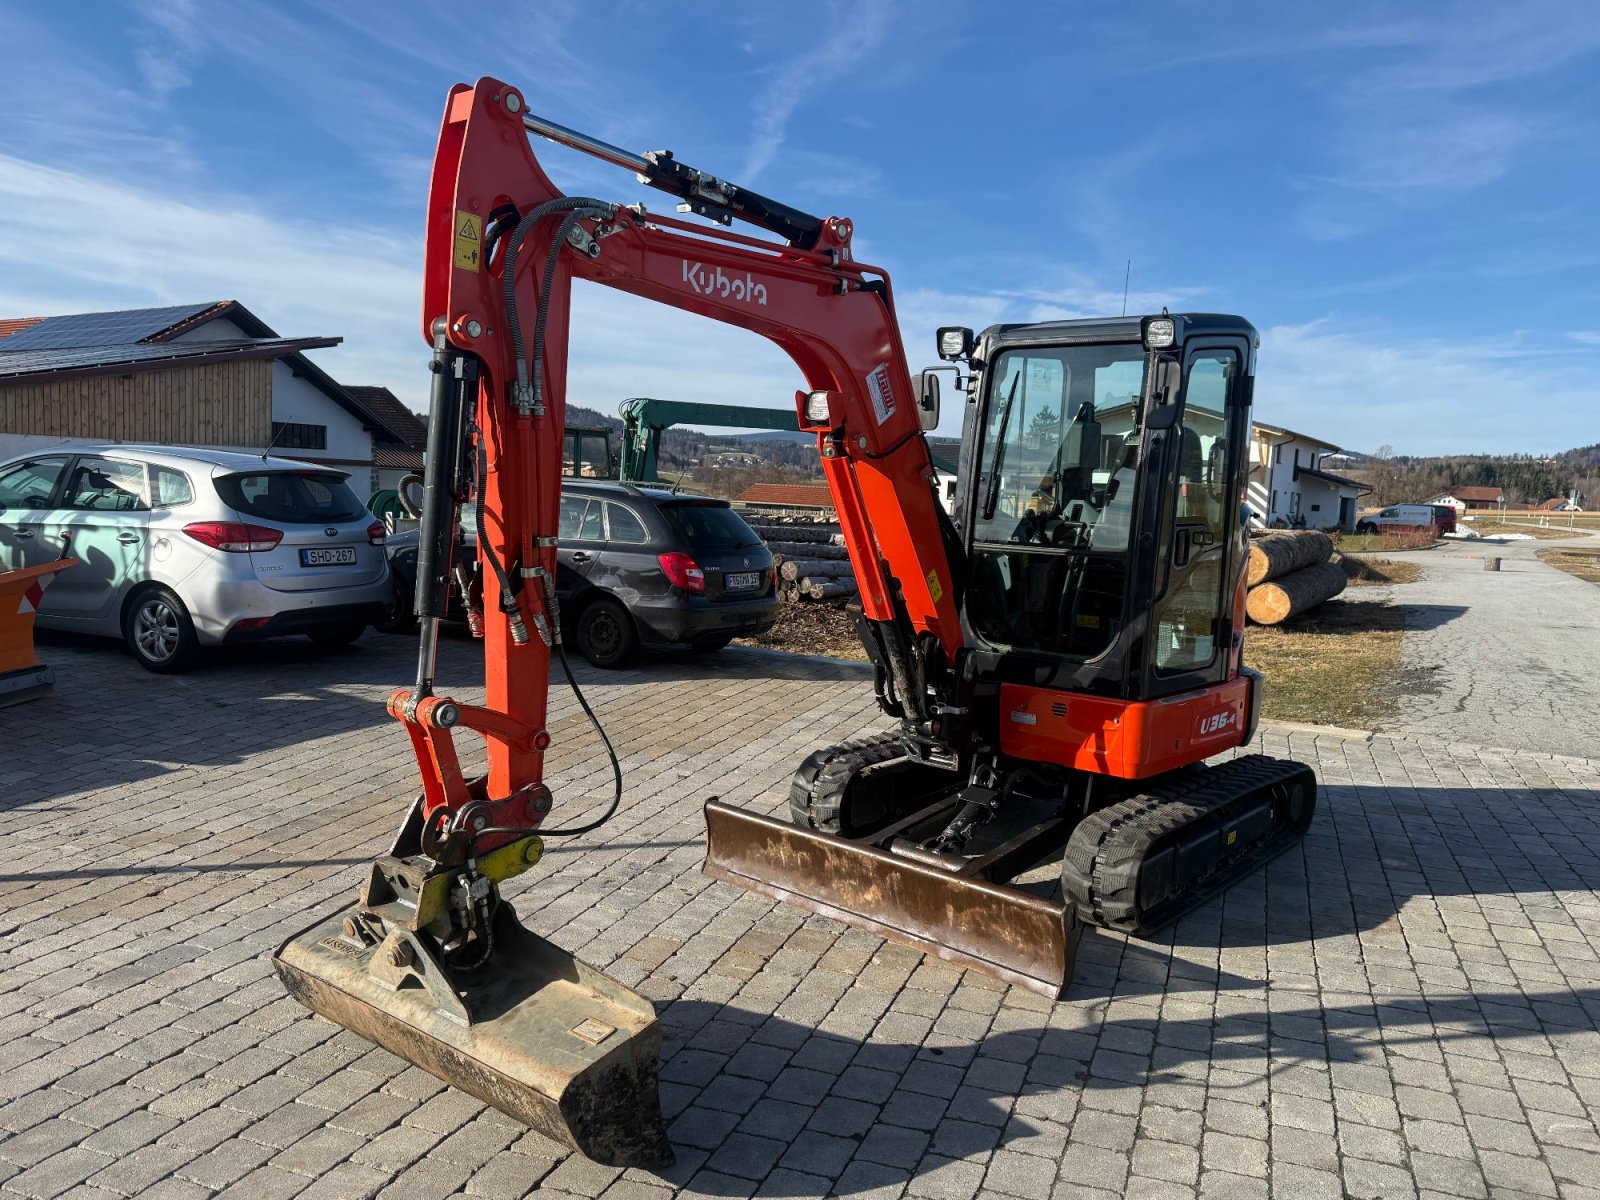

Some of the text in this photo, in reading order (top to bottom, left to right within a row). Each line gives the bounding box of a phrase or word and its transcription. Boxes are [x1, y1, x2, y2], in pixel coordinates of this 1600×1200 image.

[682, 259, 767, 305] Kubota
[310, 550, 353, 563] SHD-267
[1200, 711, 1236, 735] U36-4
